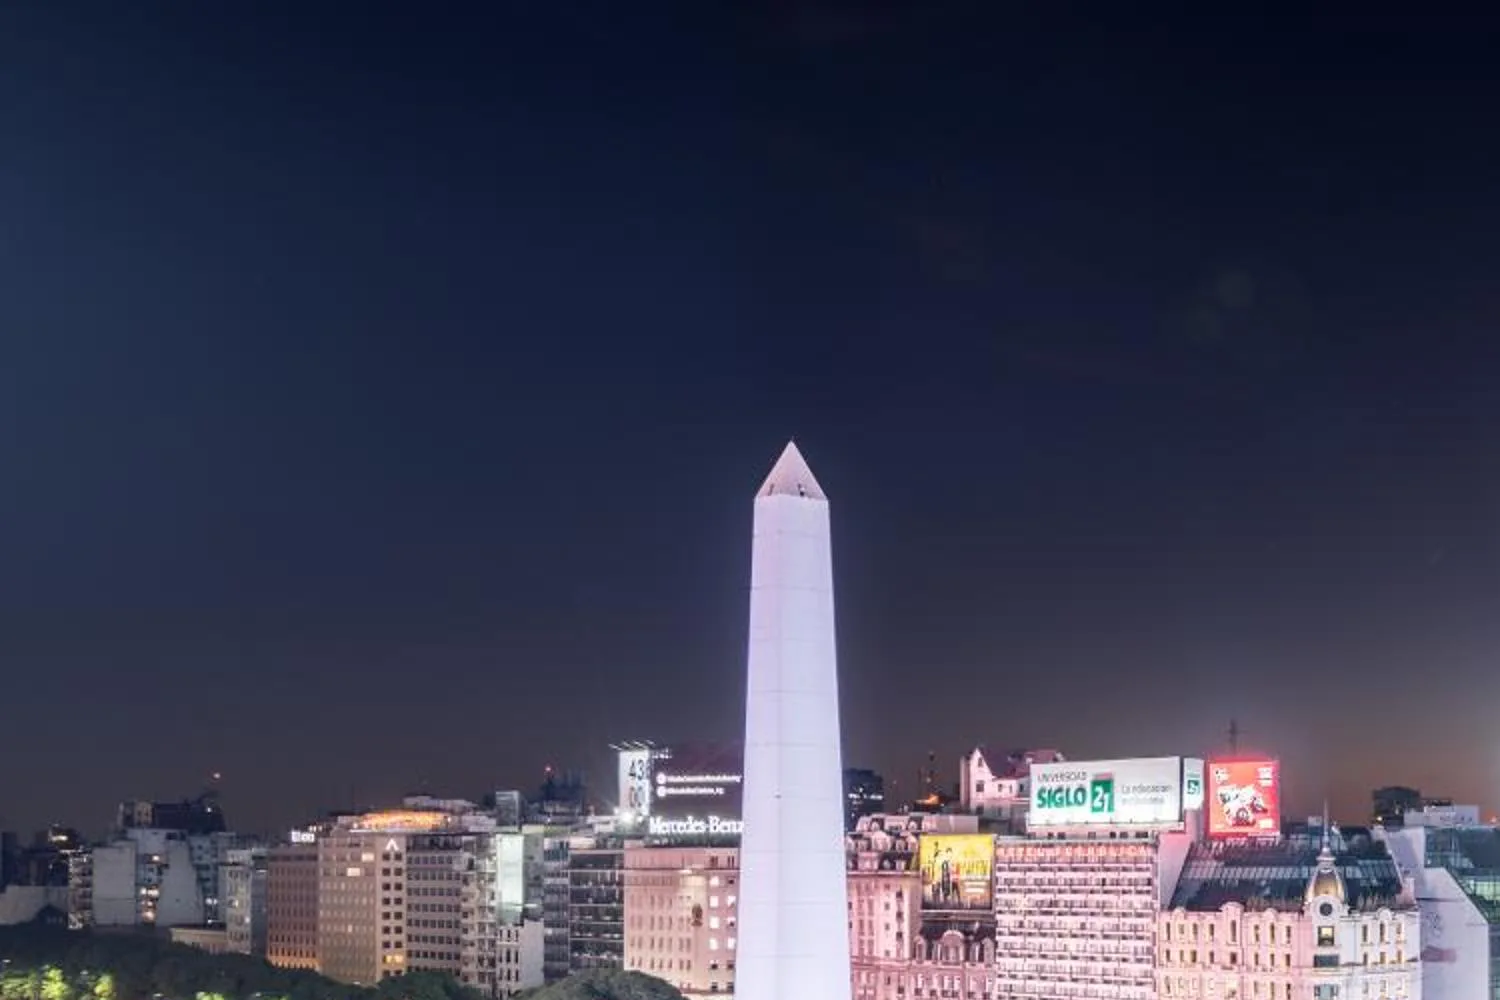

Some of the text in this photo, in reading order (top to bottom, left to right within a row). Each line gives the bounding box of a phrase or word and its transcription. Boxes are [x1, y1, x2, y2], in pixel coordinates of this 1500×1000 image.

[1037, 771, 1088, 782] UNIVERSIDAD
[1037, 784, 1111, 813] SIGLO 21
